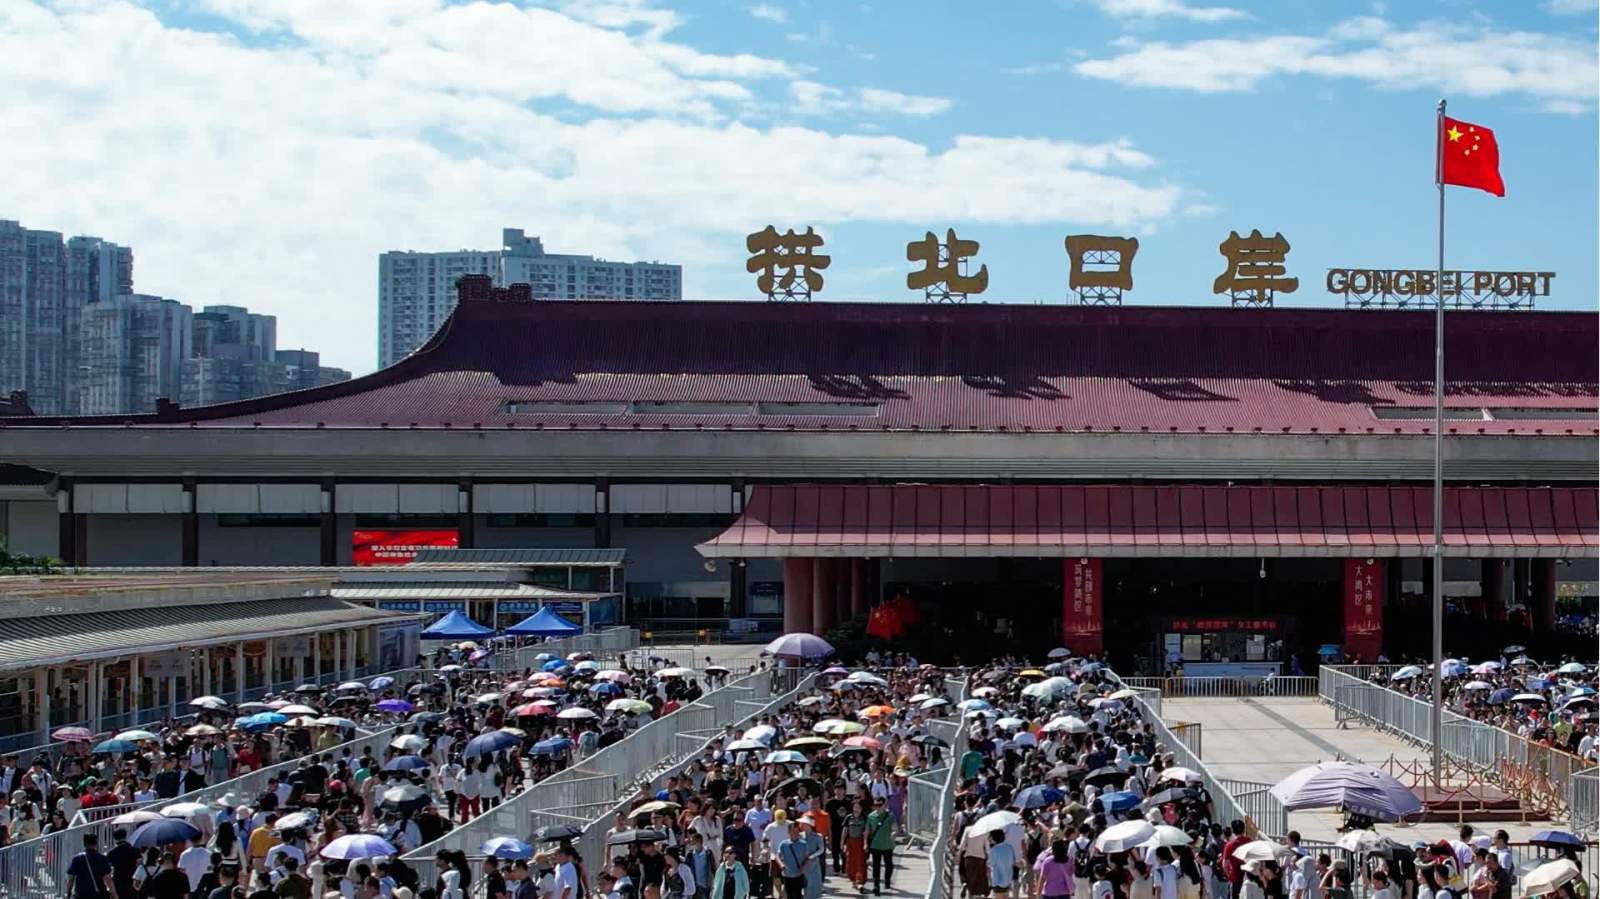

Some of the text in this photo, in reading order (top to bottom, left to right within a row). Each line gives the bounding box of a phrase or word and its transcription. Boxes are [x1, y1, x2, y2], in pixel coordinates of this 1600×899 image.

[746, 225, 1299, 303] 拱北口岸
[1326, 268, 1557, 297] GONGBEI PORT
